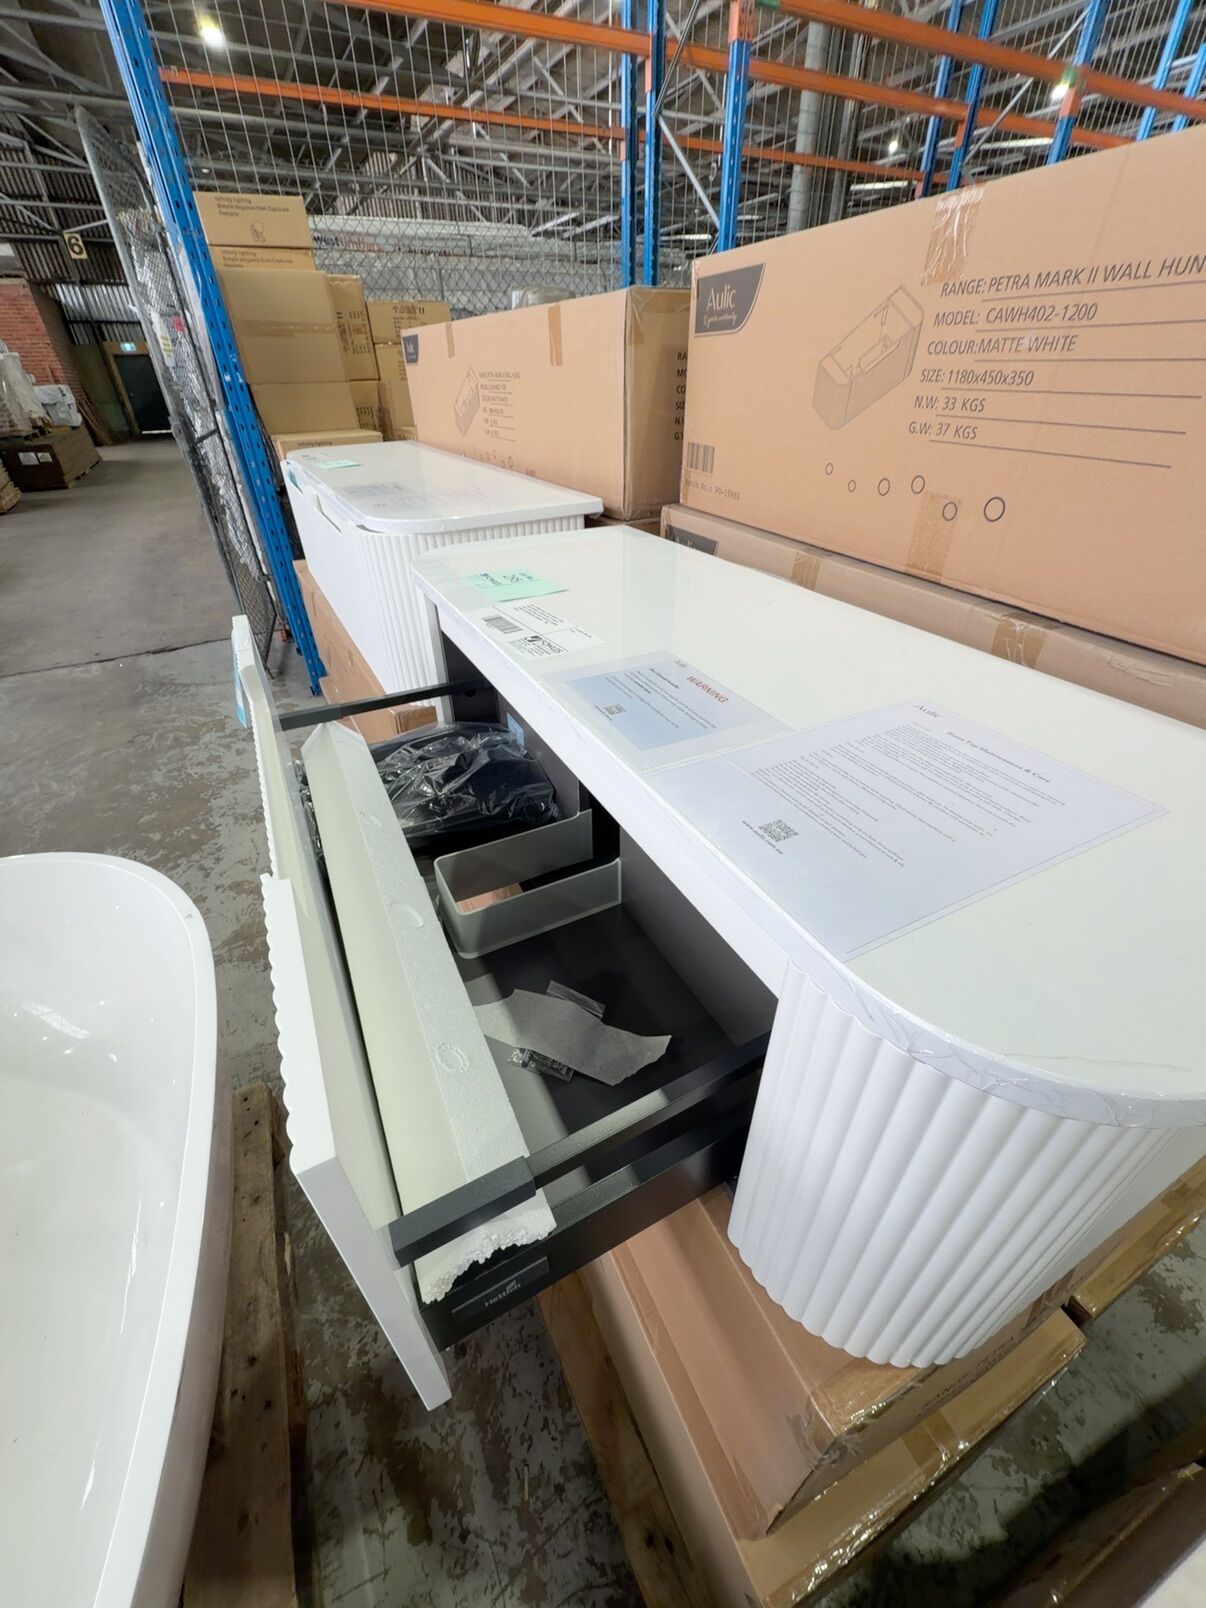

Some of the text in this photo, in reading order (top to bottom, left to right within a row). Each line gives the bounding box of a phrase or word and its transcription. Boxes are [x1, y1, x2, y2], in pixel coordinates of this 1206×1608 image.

[67, 236, 85, 256] 6
[940, 278, 987, 298] RANGE:
[988, 273, 1030, 294] PETRA
[1034, 267, 1085, 289] MARK
[1087, 265, 1099, 285] II
[1104, 259, 1152, 282] WALL
[705, 283, 737, 312] Aulic
[933, 302, 1099, 327] MODEL: CAWH402-1200
[1027, 334, 1079, 353] WHITE
[920, 367, 1035, 387] SIZE: 1180x450x350
[913, 395, 986, 413] N.W: 33 KGS
[908, 420, 978, 441] G.W: 37 KGS
[686, 675, 729, 703] WARNING
